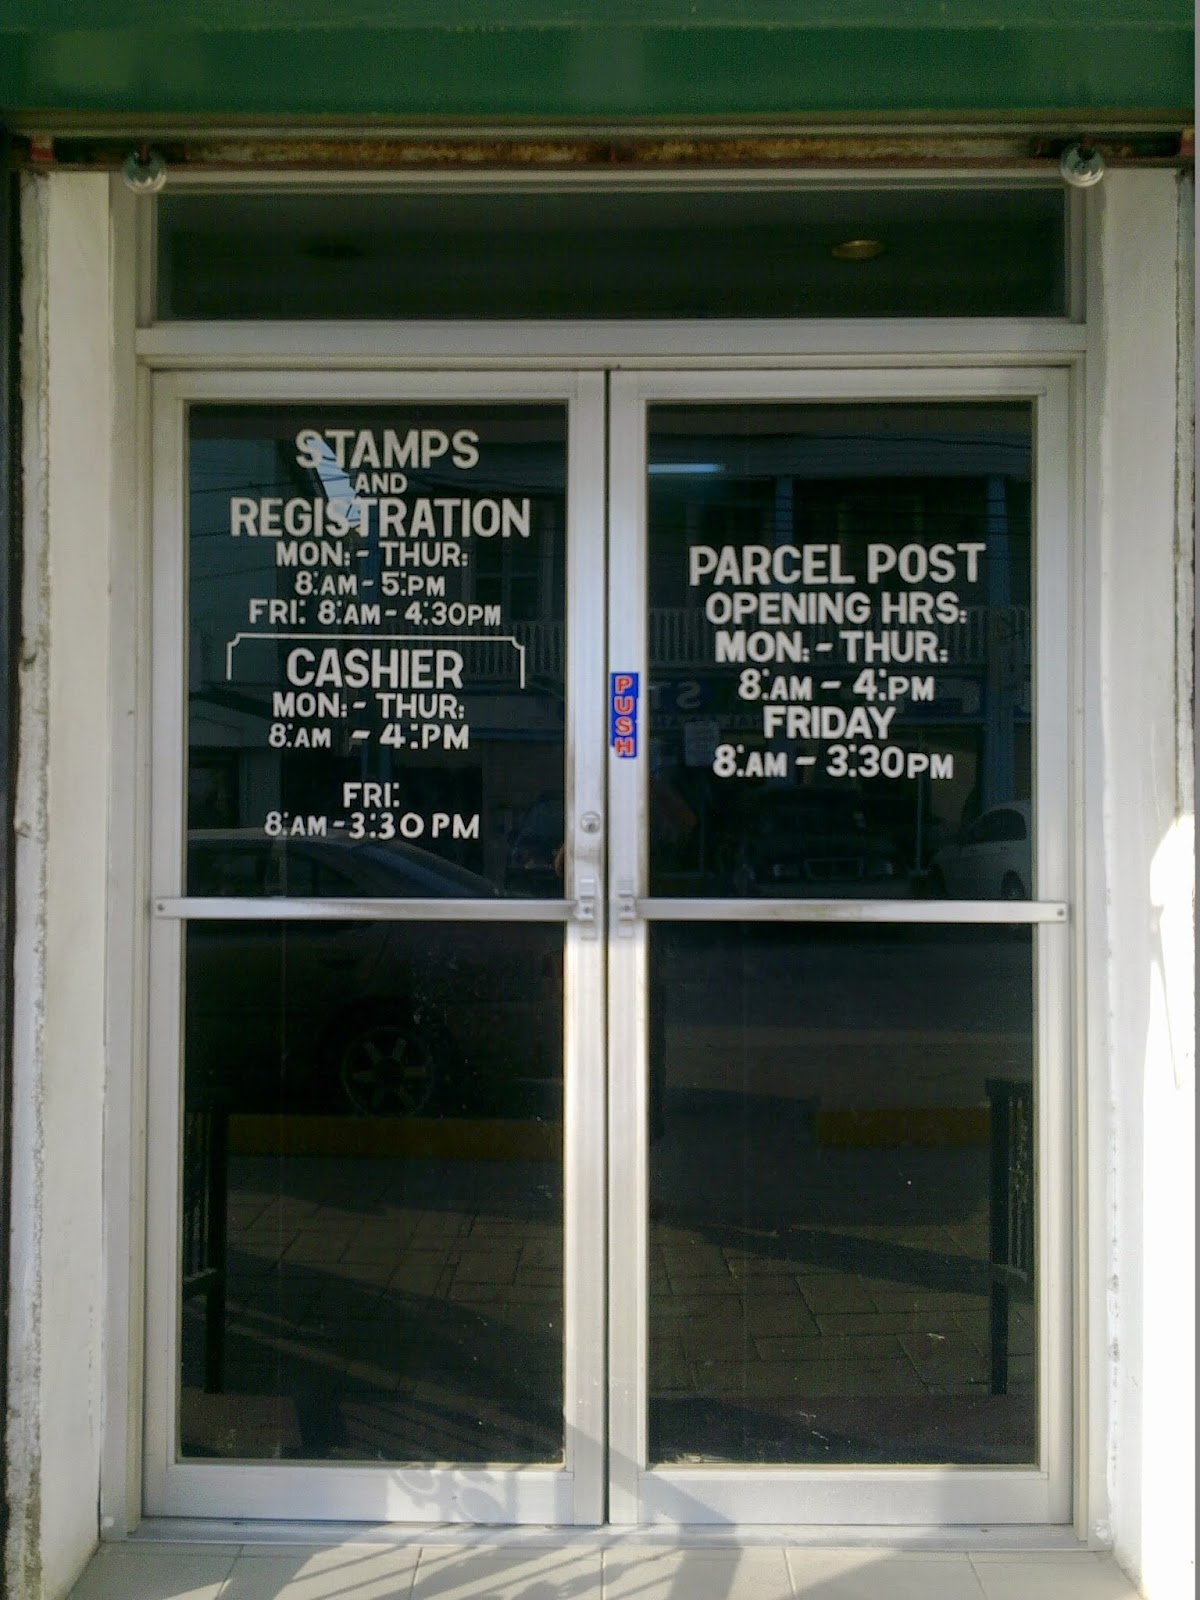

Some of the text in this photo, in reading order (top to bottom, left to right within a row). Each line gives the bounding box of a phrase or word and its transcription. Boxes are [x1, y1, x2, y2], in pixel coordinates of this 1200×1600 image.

[296, 429, 480, 469] STAMPS
[355, 472, 408, 495] AND
[230, 497, 530, 538] REGISTRATION
[378, 541, 468, 567] THUR:
[689, 542, 986, 586] PARCEL POST
[705, 591, 967, 625] OPENING HRS:
[839, 630, 948, 663] THUR:
[287, 647, 464, 689] CASHIER
[375, 692, 465, 720] THUR:
[614, 675, 635, 756] PUSH
[763, 705, 897, 740] FRIDAY
